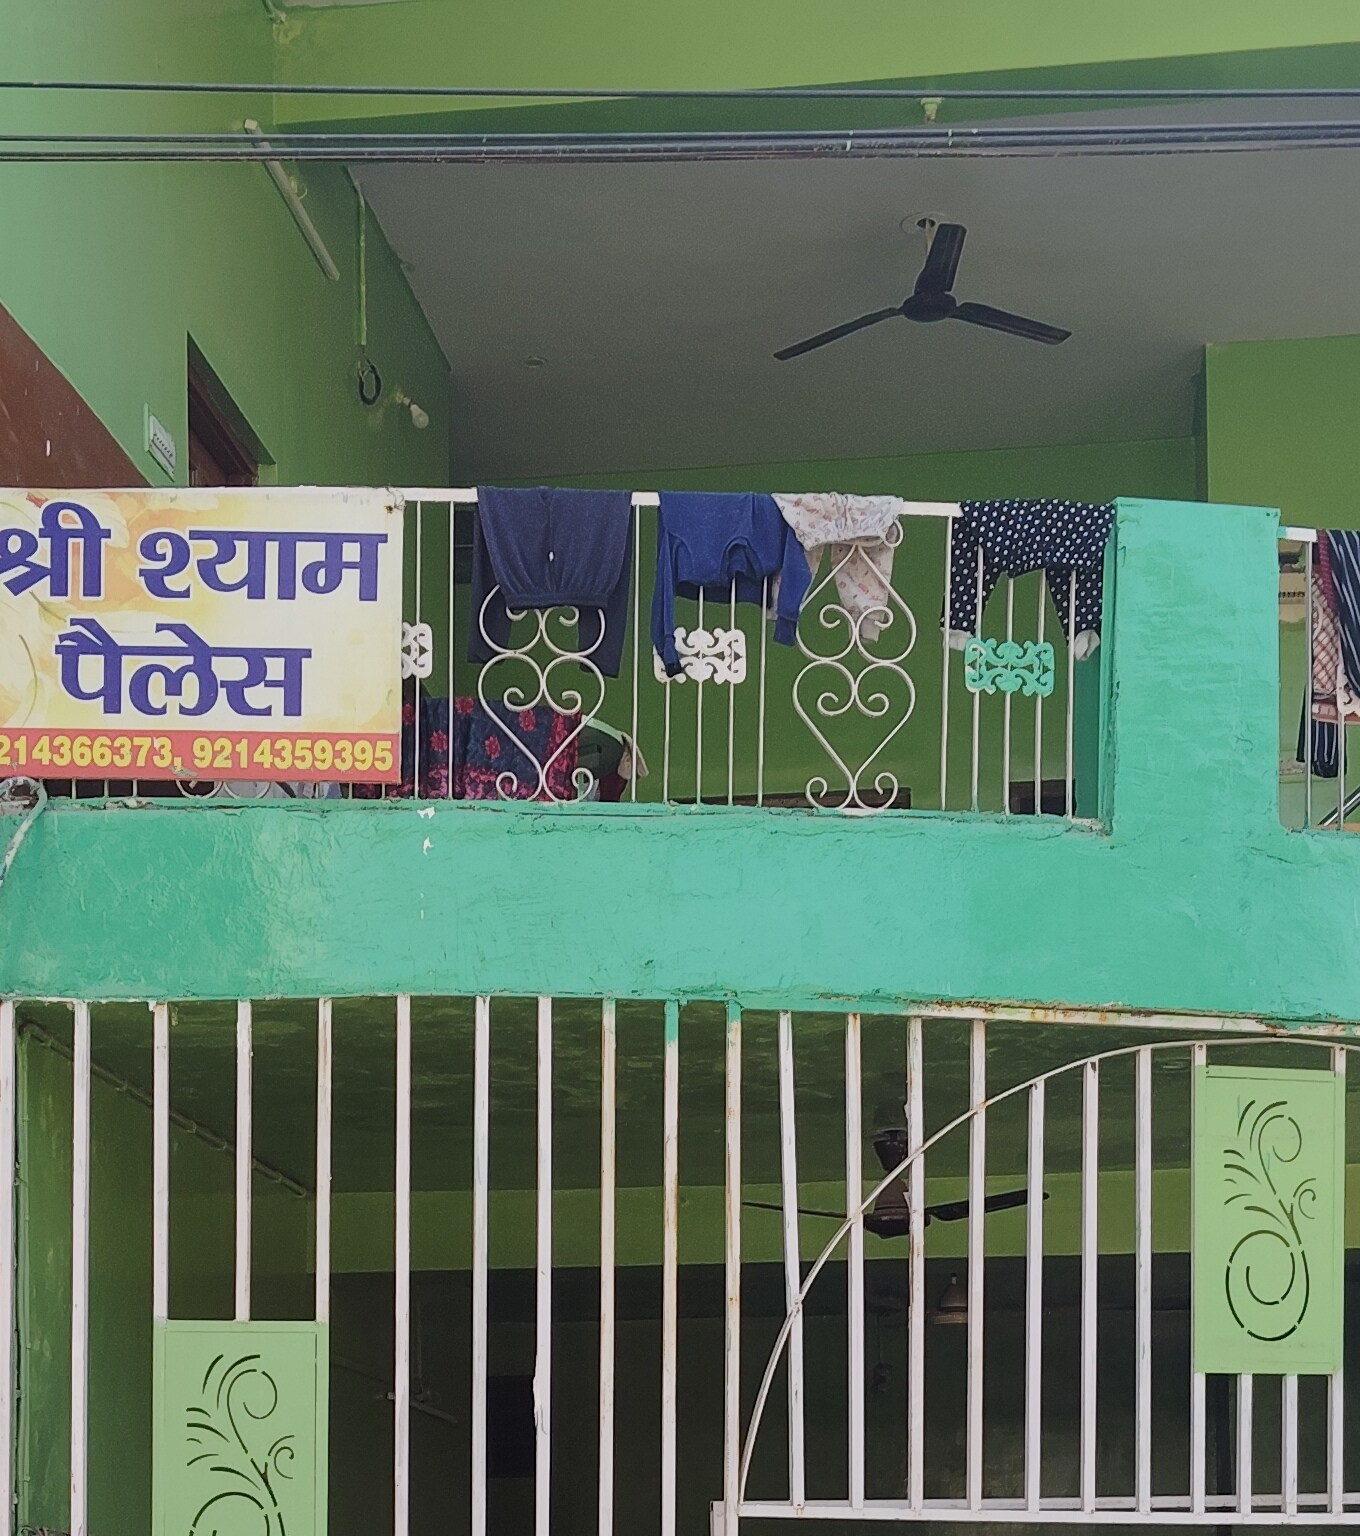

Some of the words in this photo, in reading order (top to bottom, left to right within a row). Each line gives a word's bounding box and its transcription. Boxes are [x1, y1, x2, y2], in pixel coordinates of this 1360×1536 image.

[139, 529, 389, 602] श्याम
[54, 617, 313, 718] पैलेस
[193, 736, 394, 772] 9214359395
